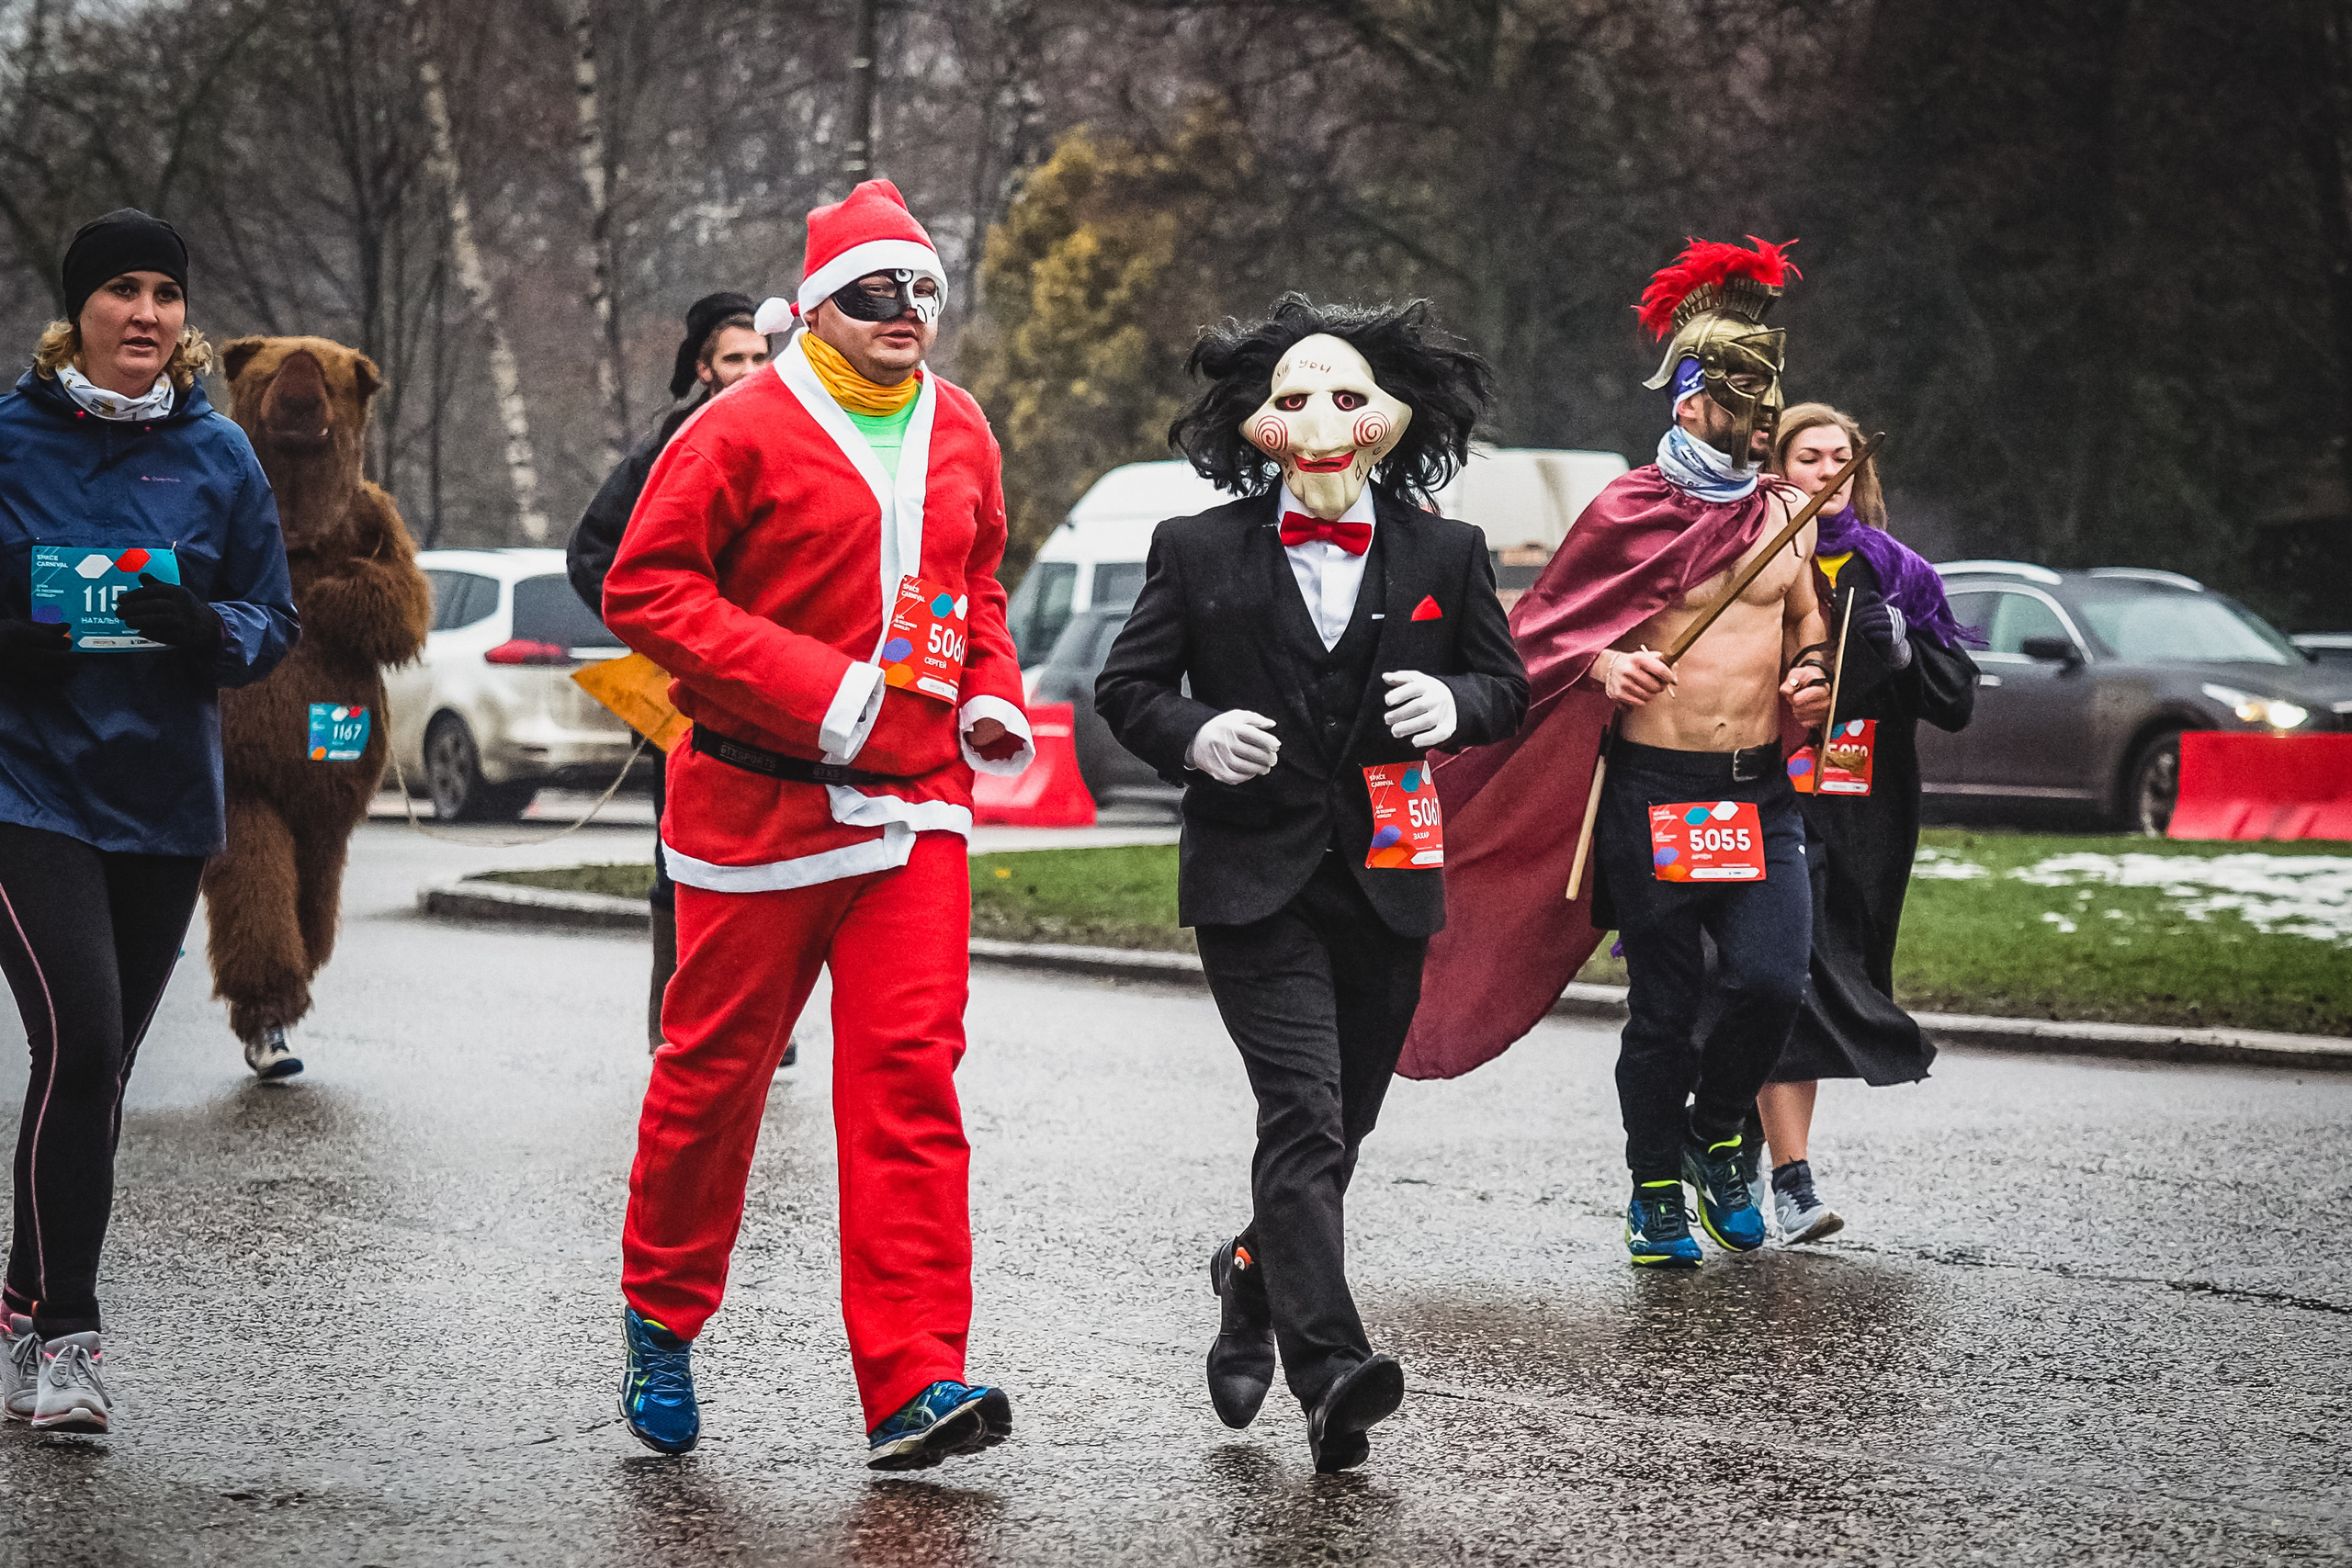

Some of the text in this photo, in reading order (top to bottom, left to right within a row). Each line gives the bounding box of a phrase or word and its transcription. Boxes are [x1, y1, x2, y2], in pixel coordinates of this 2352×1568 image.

[81, 616, 120, 625] НАТАЛЬЯ
[924, 656, 947, 670] СЕРГЕЙ
[334, 723, 362, 741] 1167
[1371, 779, 1395, 788] CARNIVAL
[1413, 831, 1430, 840] ЗАХАР
[1690, 828, 1751, 852] 5055
